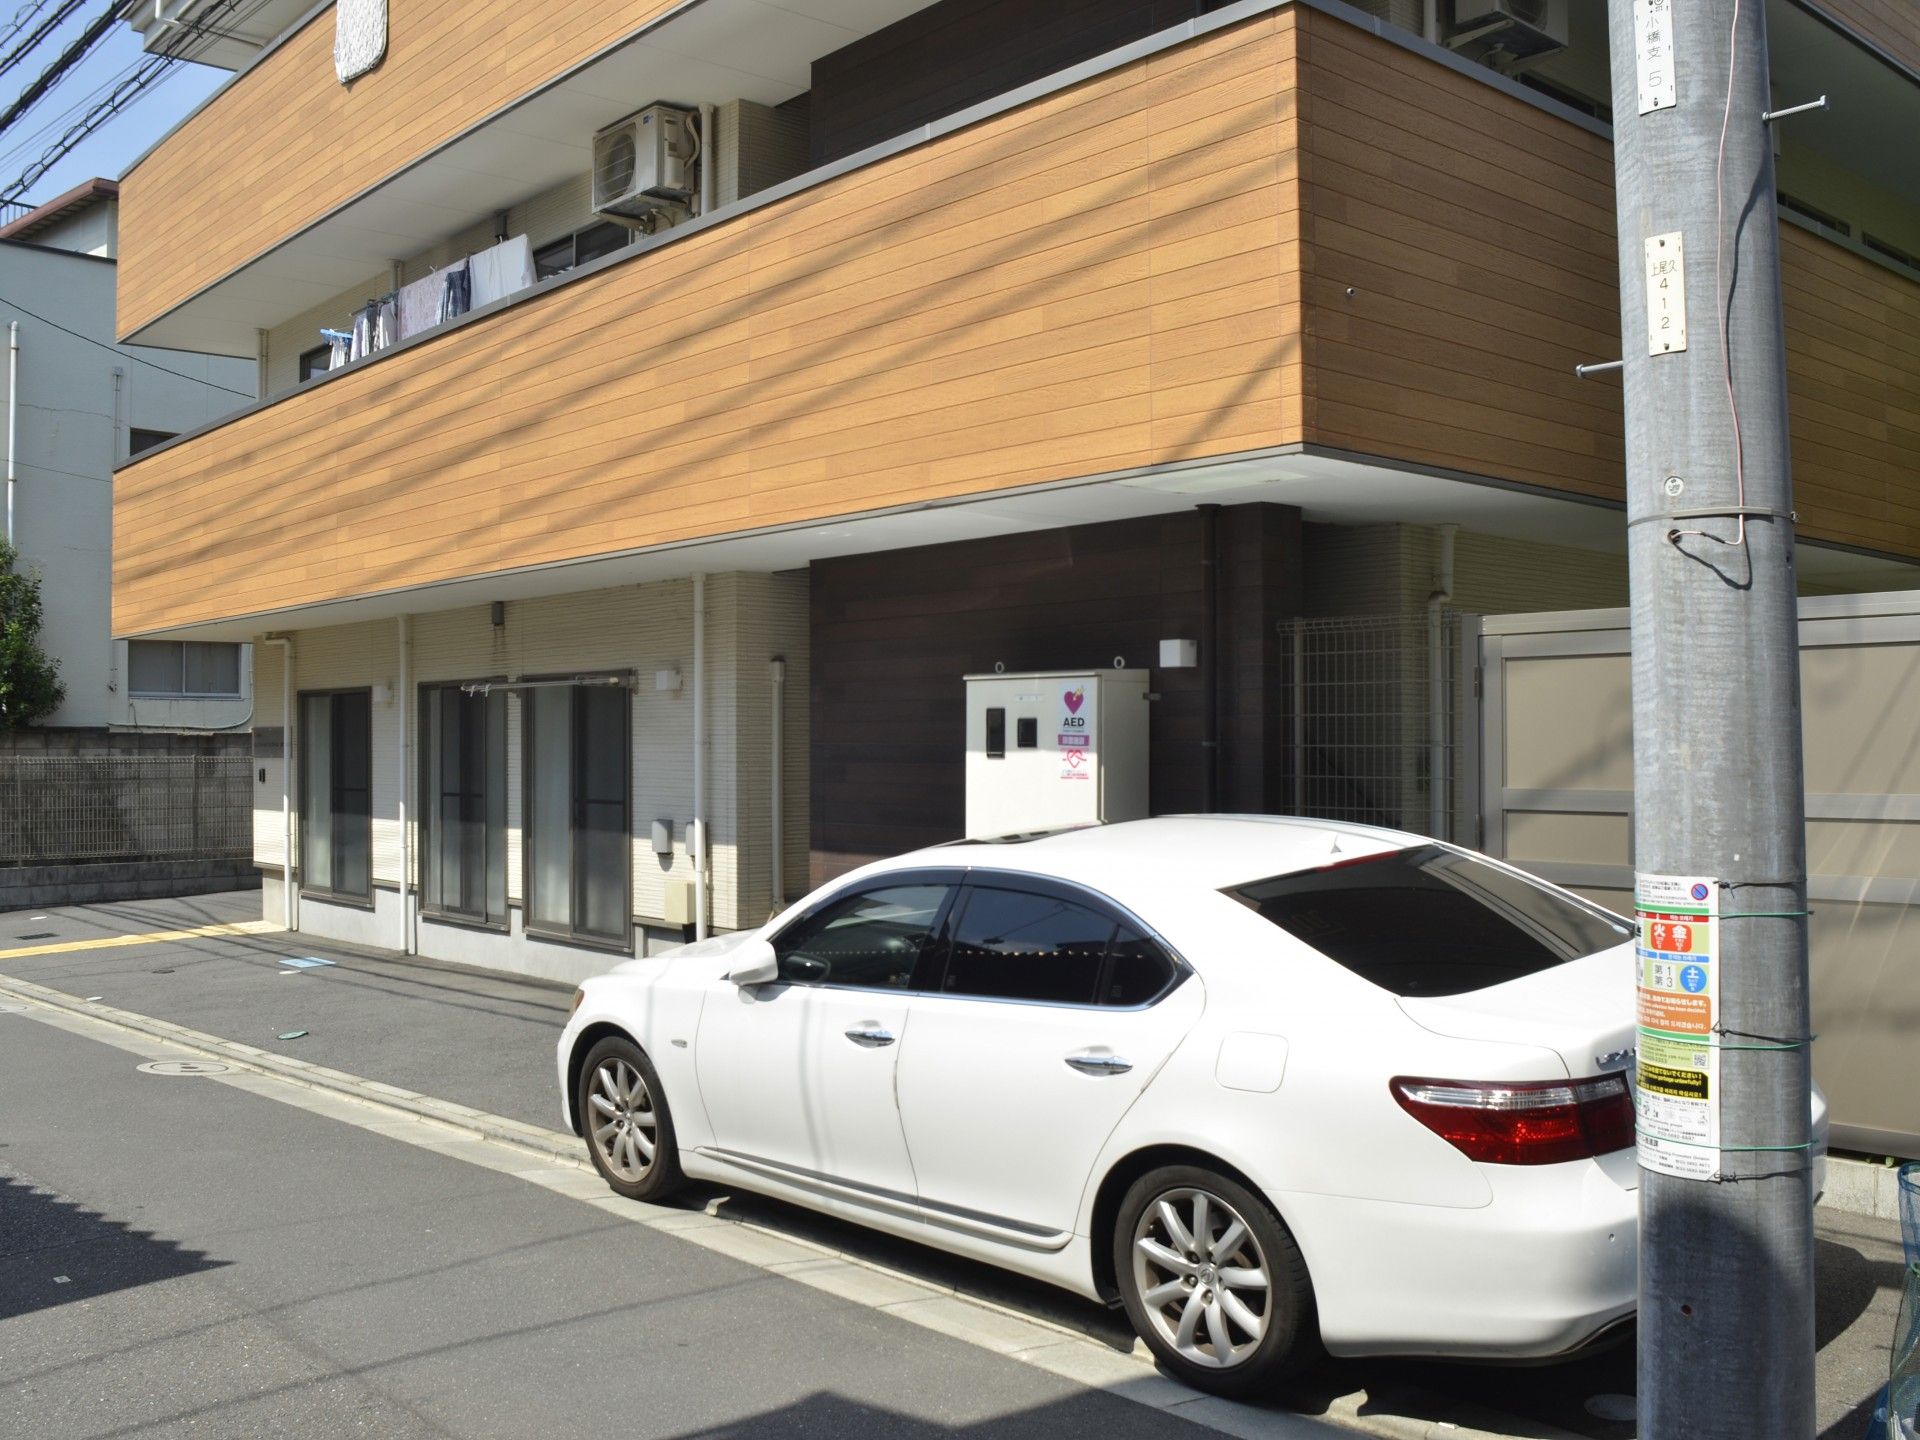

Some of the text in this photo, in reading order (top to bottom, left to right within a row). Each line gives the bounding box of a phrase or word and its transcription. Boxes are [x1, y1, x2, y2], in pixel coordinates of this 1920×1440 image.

[1649, 70, 1663, 88] 5
[1651, 260, 1678, 277] 上尾久
[1063, 717, 1086, 727] AED
[1654, 923, 1666, 937] 火
[1672, 925, 1687, 939] 金
[1687, 967, 1699, 979] 土
